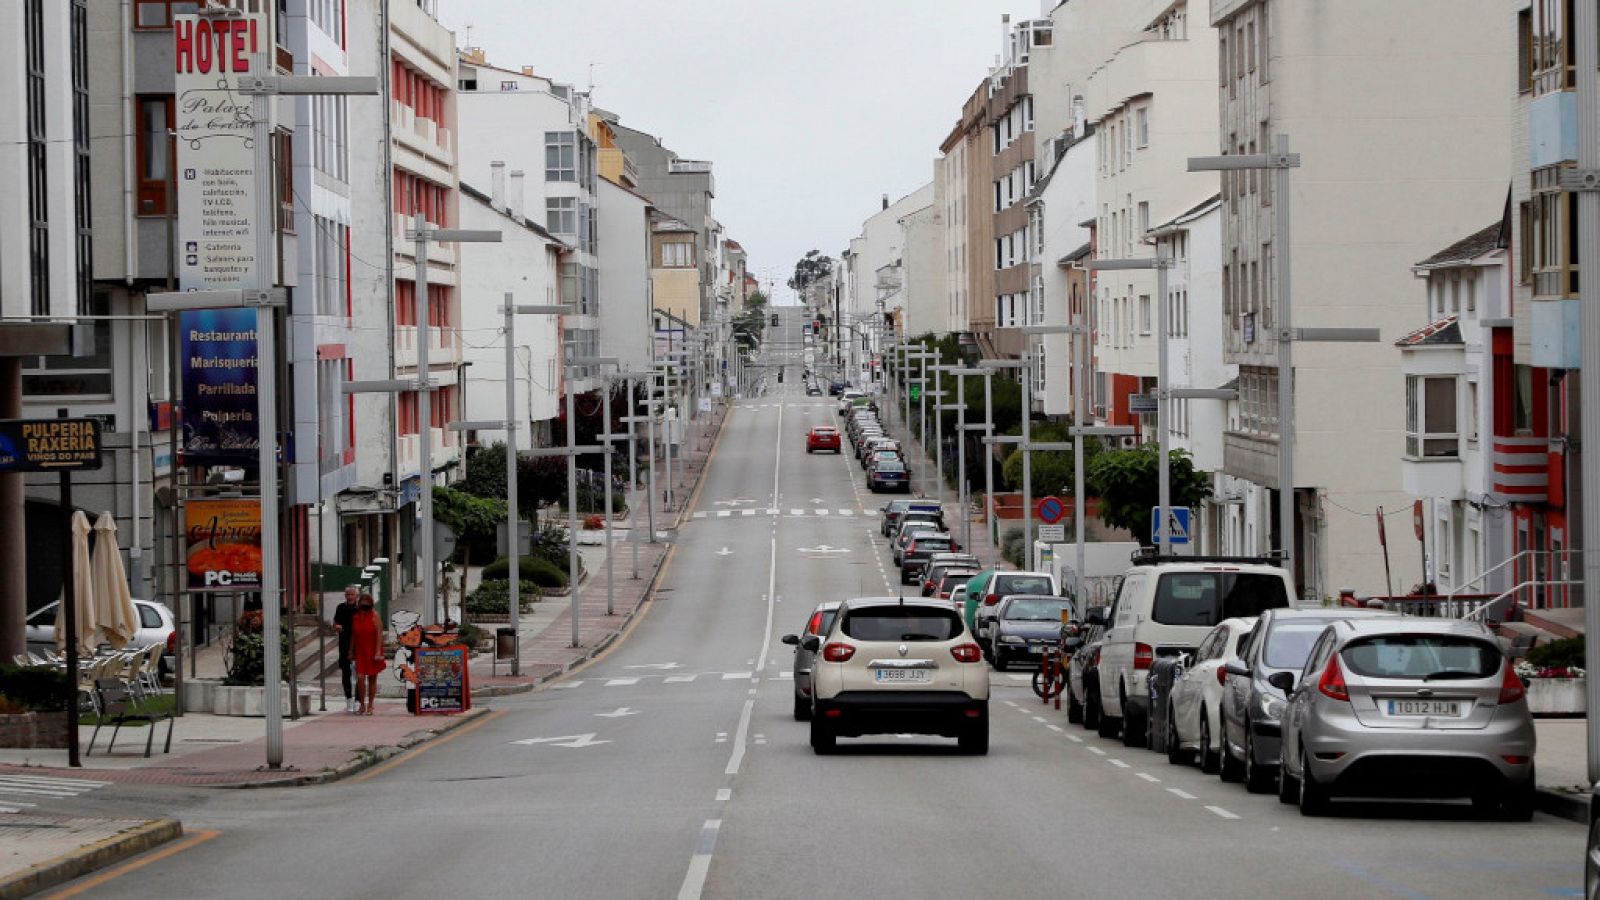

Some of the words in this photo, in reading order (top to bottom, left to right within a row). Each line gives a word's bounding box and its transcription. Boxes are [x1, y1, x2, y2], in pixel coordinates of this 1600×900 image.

[198, 383, 256, 395] Parrillada
[22, 421, 94, 438] PULPERIA
[28, 436, 95, 452] RAXERIA
[27, 452, 57, 462] VINOS
[204, 570, 232, 585] PC
[1399, 702, 1429, 713] 1012
